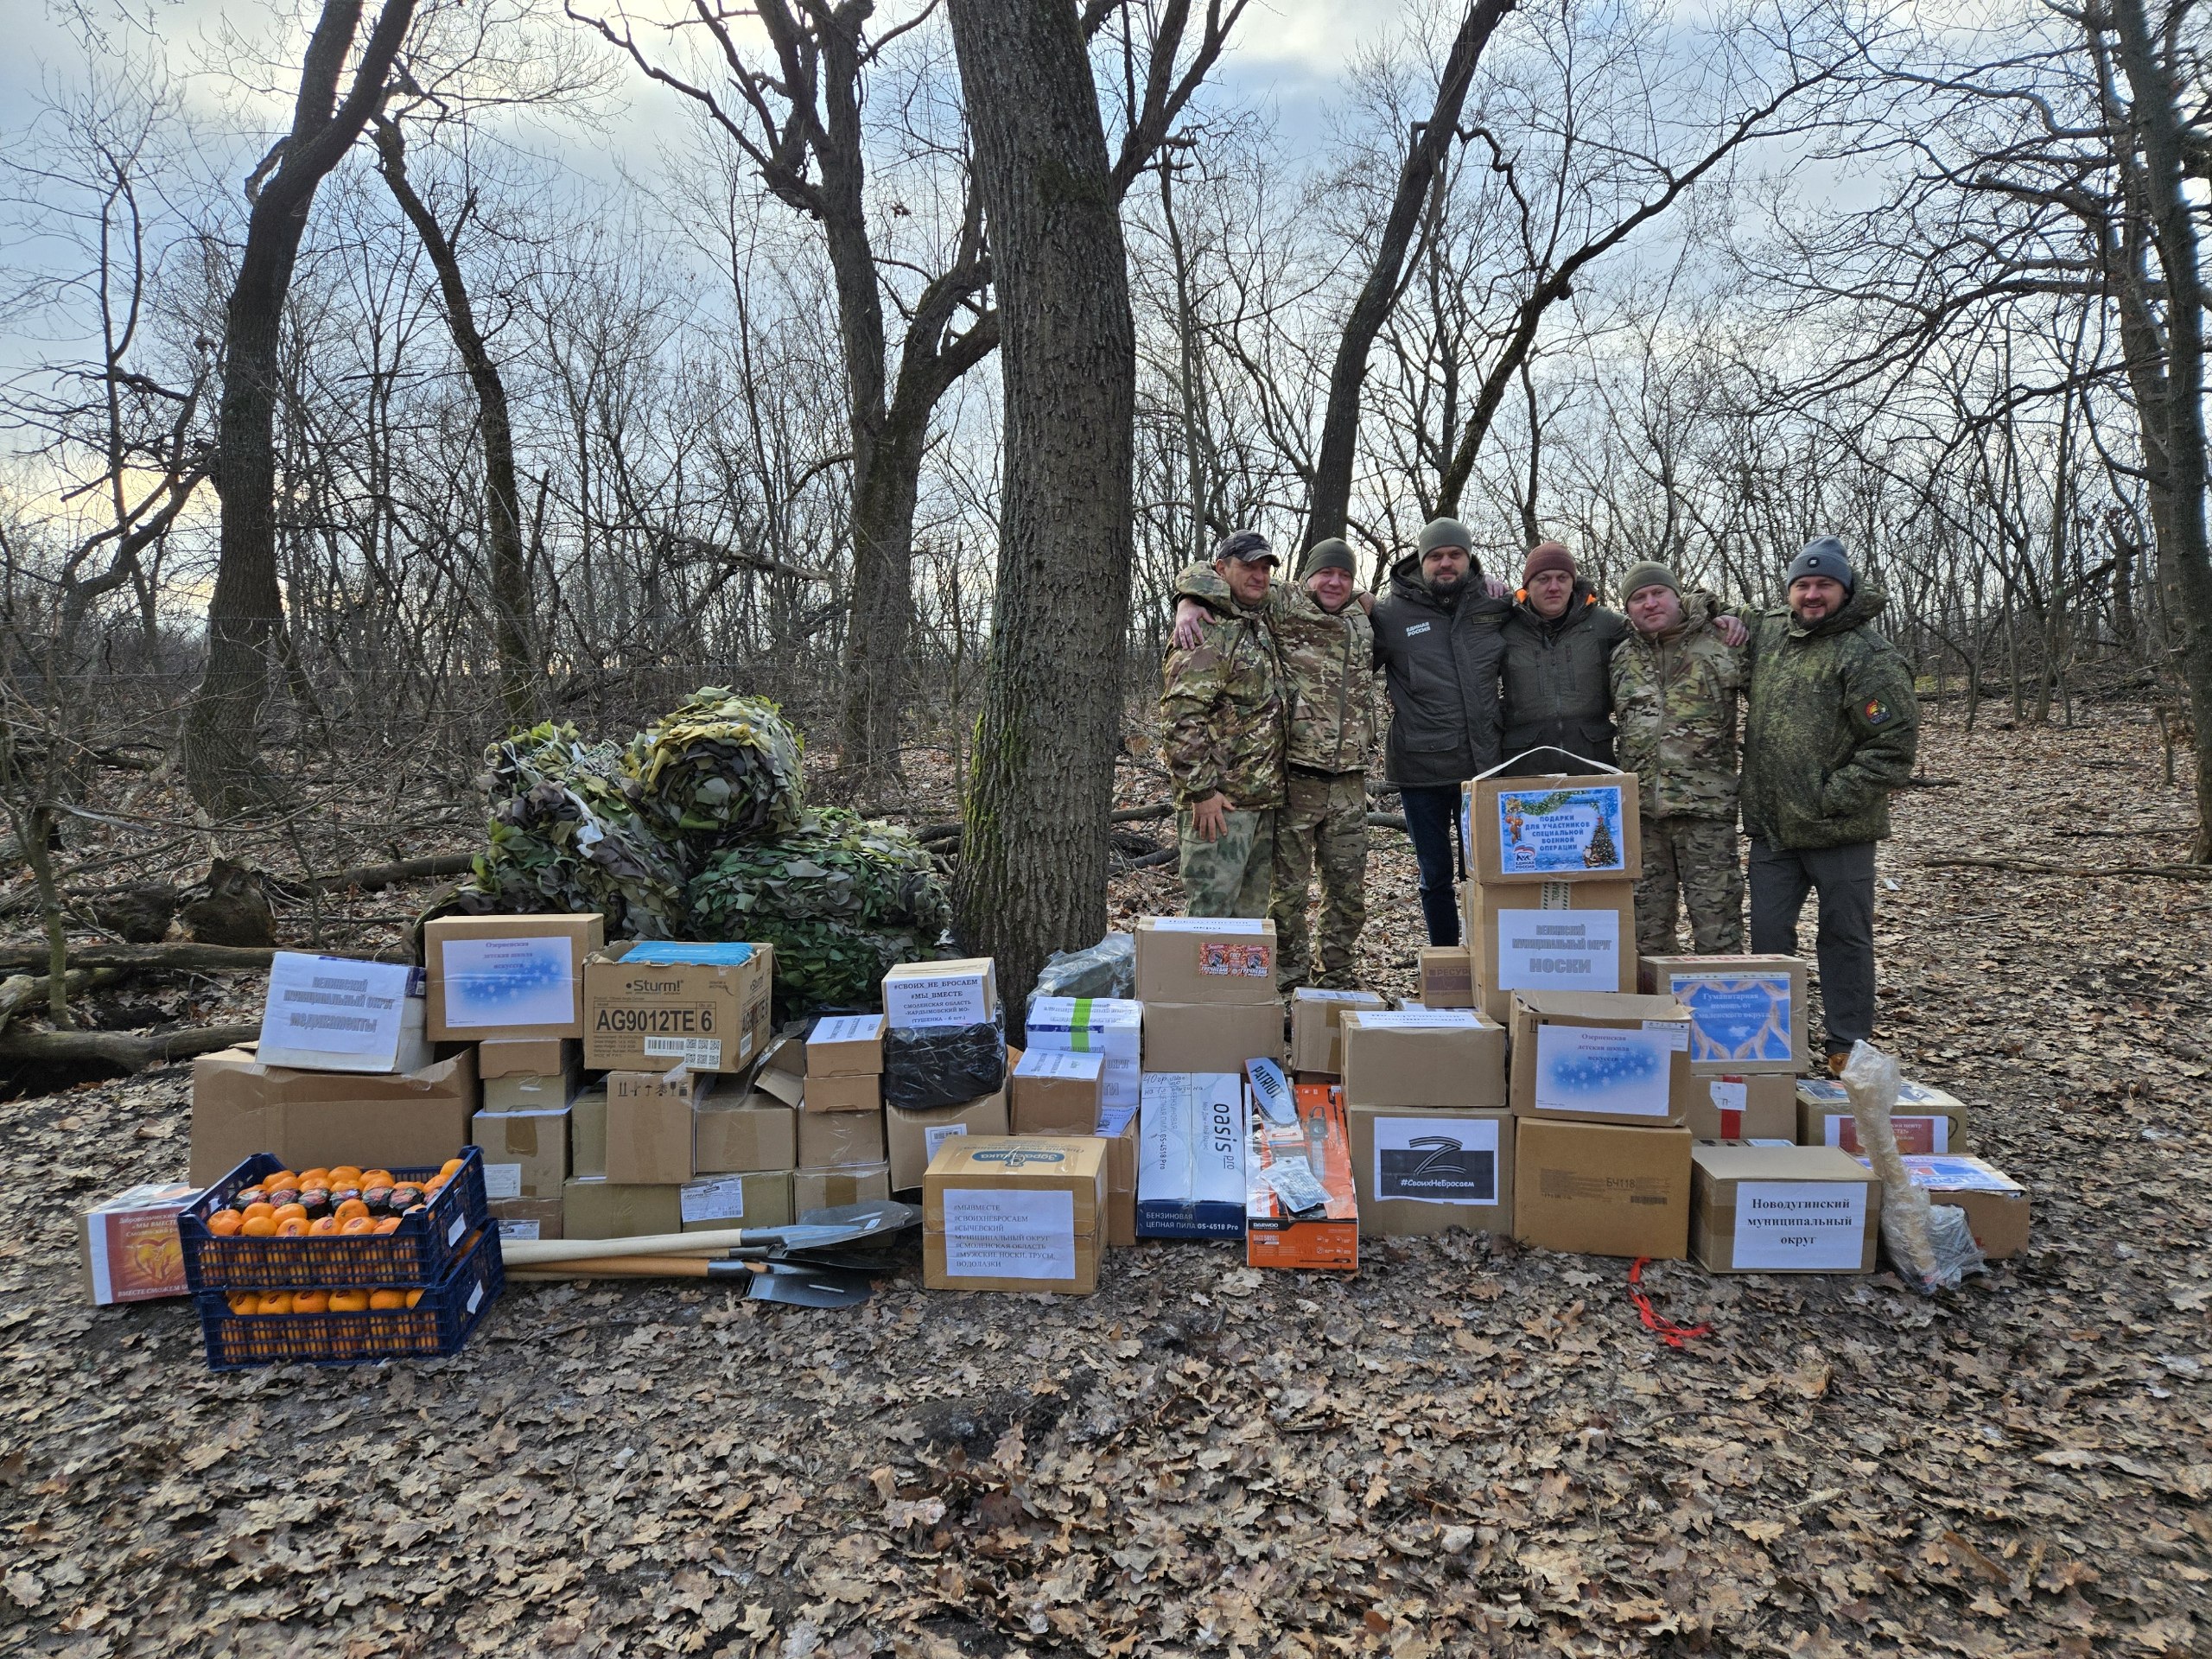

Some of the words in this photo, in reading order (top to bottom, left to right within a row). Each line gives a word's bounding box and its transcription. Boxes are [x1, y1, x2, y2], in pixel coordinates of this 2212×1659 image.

[1407, 626, 1431, 638] РОССИЯ
[1512, 938, 1586, 950] МУНИЦИПАЛЬНЫЙ
[1587, 940, 1611, 950] ОКРУГ
[1529, 958, 1592, 974] НОСКИ
[633, 979, 681, 992] Sturm!
[893, 979, 978, 989] #СВОИХ_НЕ_БРОСАЕМ
[283, 989, 365, 1007] МУНИЦИПАЛЬНЫЙ
[911, 990, 963, 1000] #МЫ_ВМЕСТЕ
[596, 1009, 695, 1032] AG9012TE
[701, 1009, 712, 1032] 6
[1251, 1065, 1285, 1098] PATRIOT
[1213, 1103, 1237, 1153] oasis
[1226, 1155, 1235, 1170] pro
[1401, 1179, 1474, 1188] #СвоихНеБросаем
[1752, 1198, 1850, 1211] Новодугинский
[1747, 1216, 1853, 1229] муниципальный
[125, 1228, 169, 1237] Смоленский
[1781, 1236, 1817, 1247] округ
[146, 1285, 181, 1294] СМОЖЕМ
